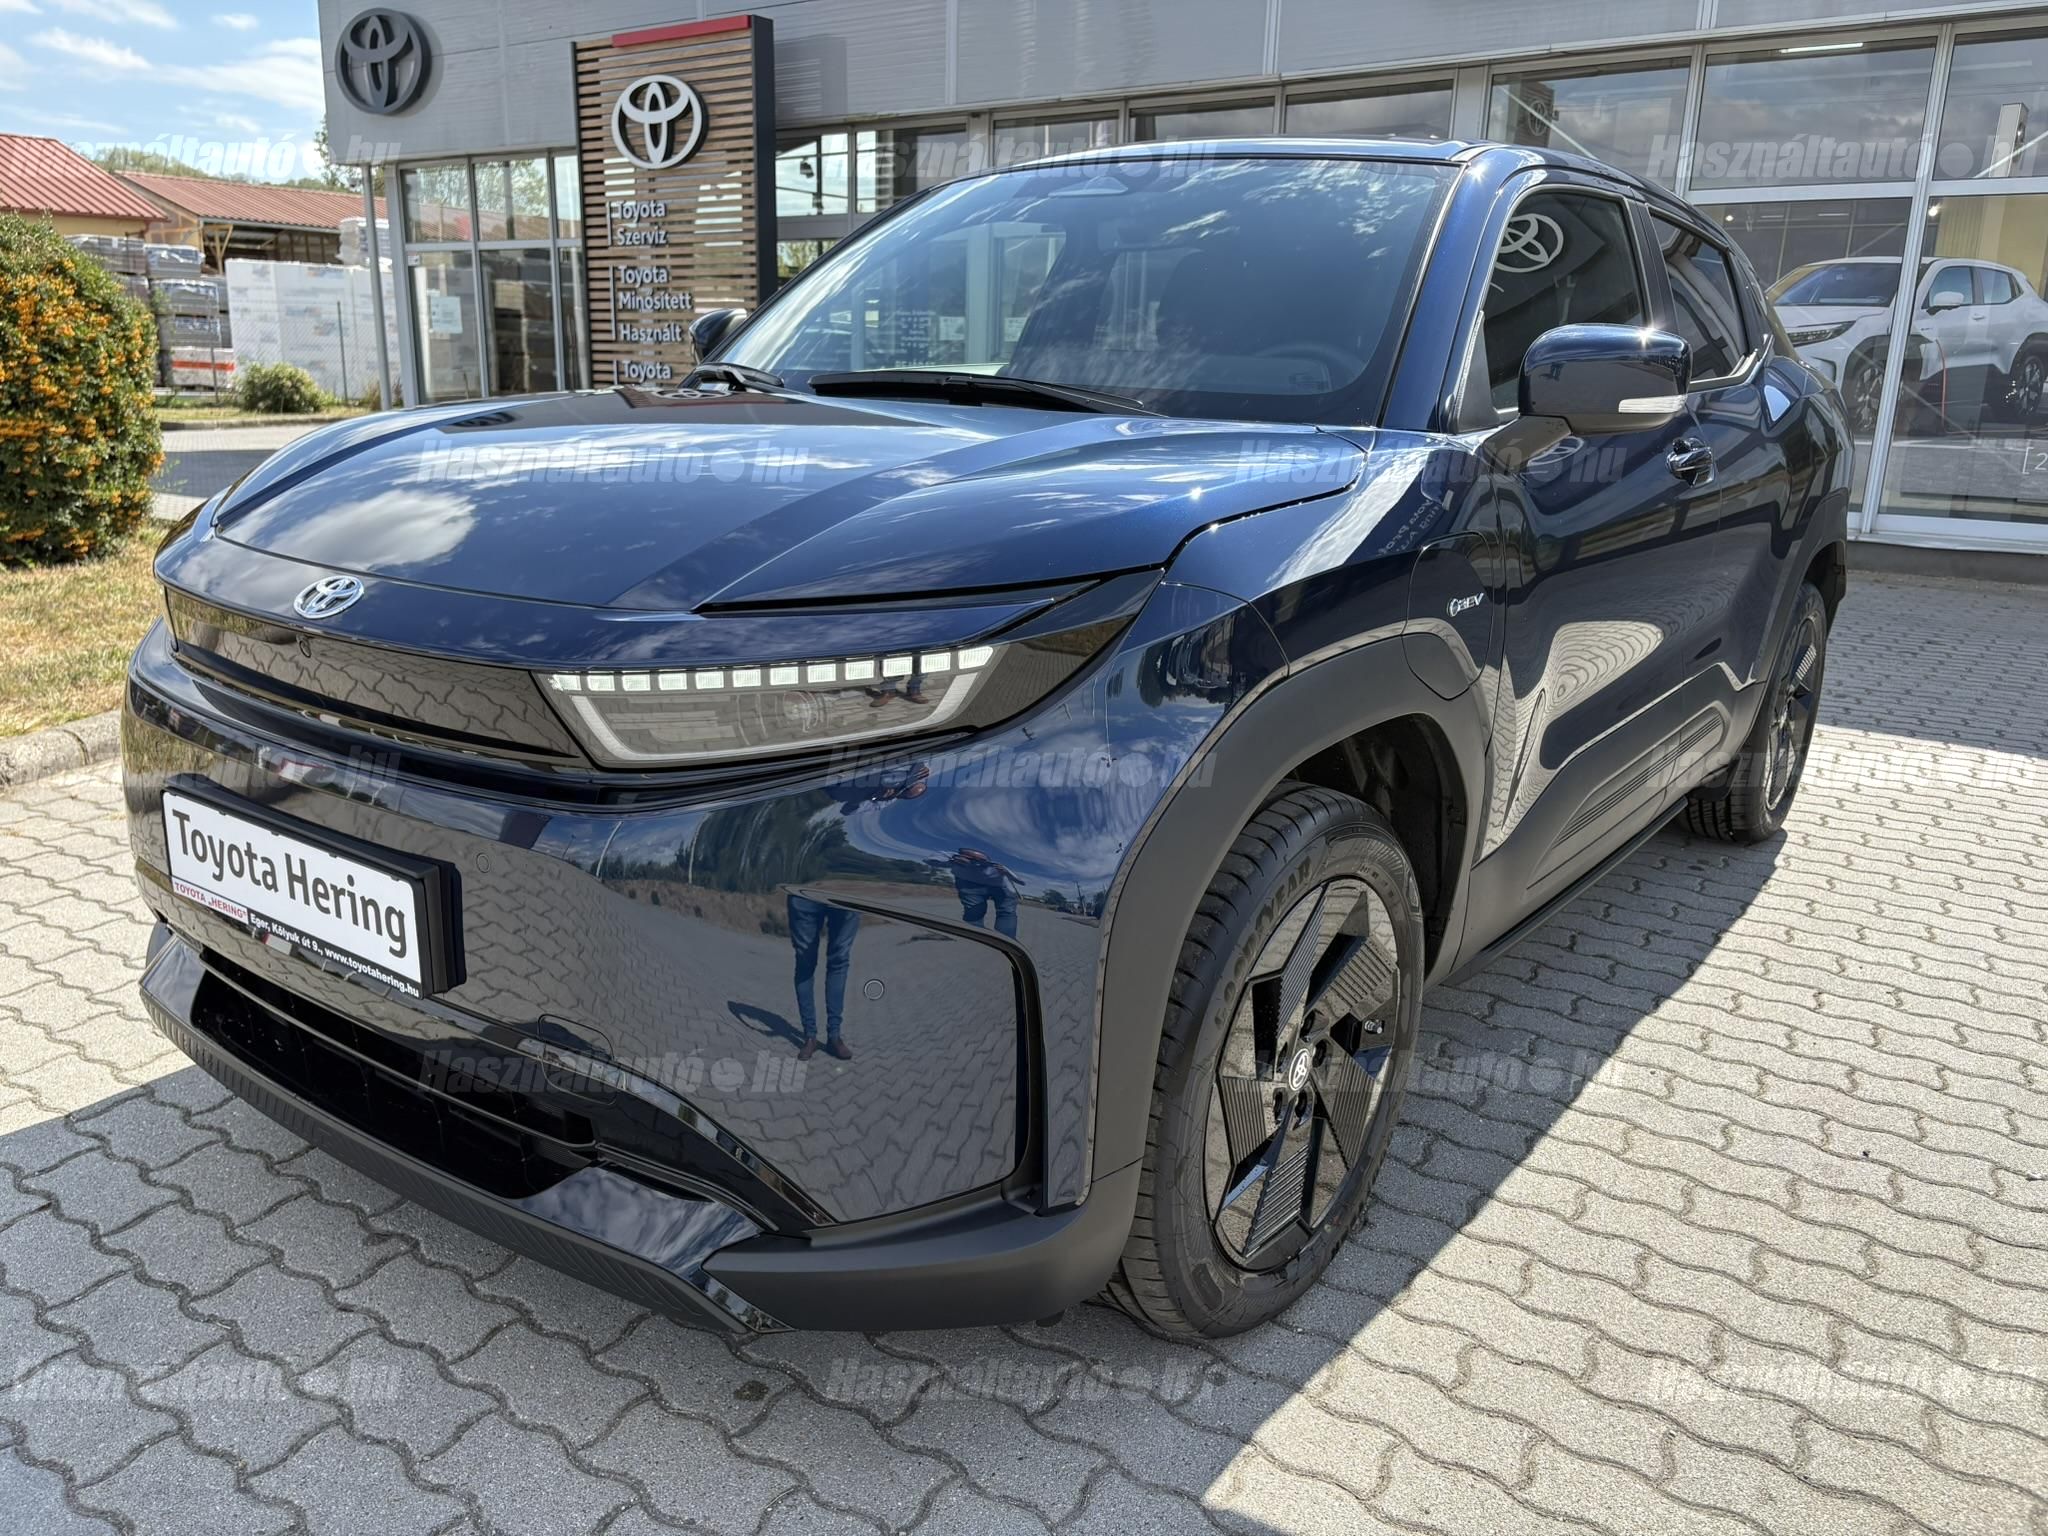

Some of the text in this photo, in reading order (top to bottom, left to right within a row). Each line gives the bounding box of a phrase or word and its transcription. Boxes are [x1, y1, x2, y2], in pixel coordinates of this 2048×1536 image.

[616, 200, 667, 223] Toyota
[617, 226, 668, 246] Szerviz
[617, 265, 668, 288] Toyota
[618, 289, 693, 310] Minősített
[620, 322, 682, 342] Használt
[622, 360, 672, 383] Toyota
[172, 809, 409, 959] Toyota Hering
[174, 881, 206, 903] TOYOTA
[249, 912, 271, 932] Eger,
[324, 947, 420, 998] www.toyotahering.hu
